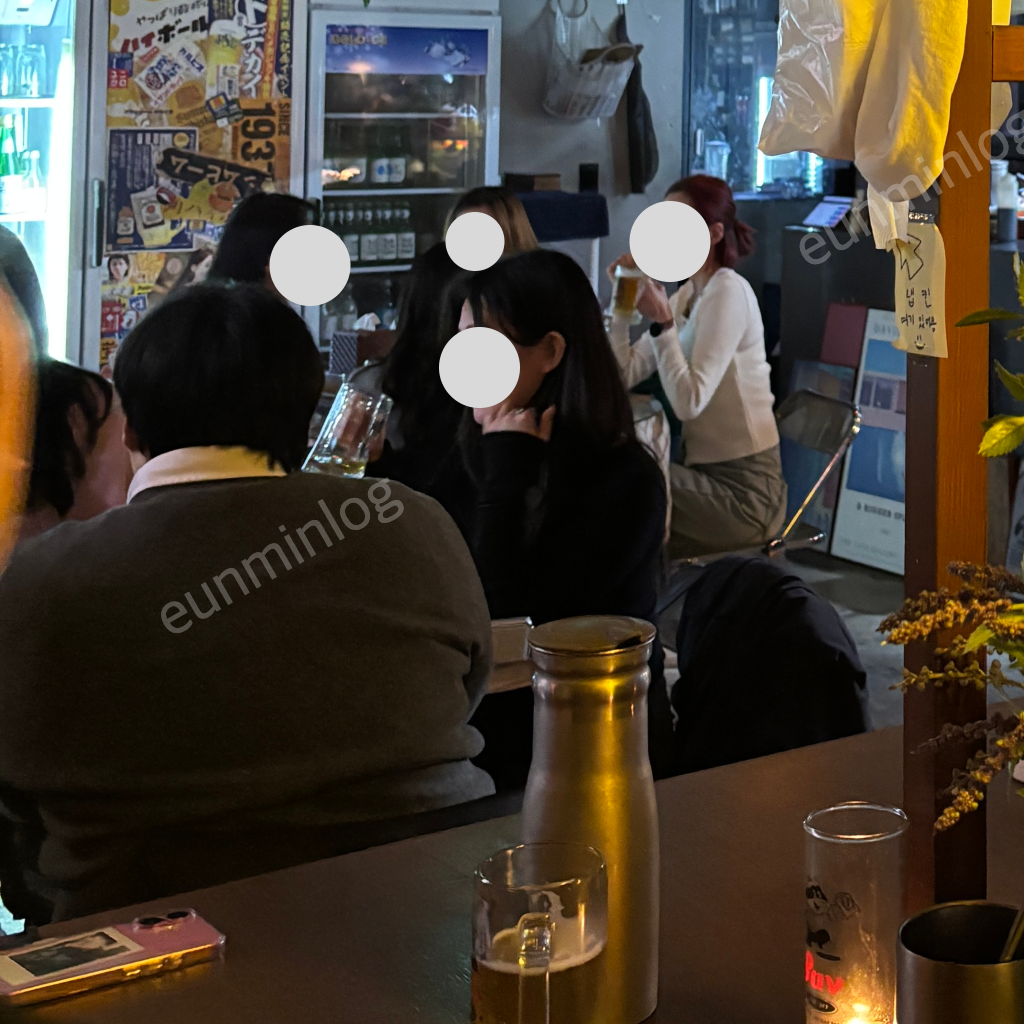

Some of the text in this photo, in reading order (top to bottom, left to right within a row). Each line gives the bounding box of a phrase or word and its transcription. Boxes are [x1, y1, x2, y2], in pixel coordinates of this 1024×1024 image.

[120, 15, 209, 53] ハイボール
